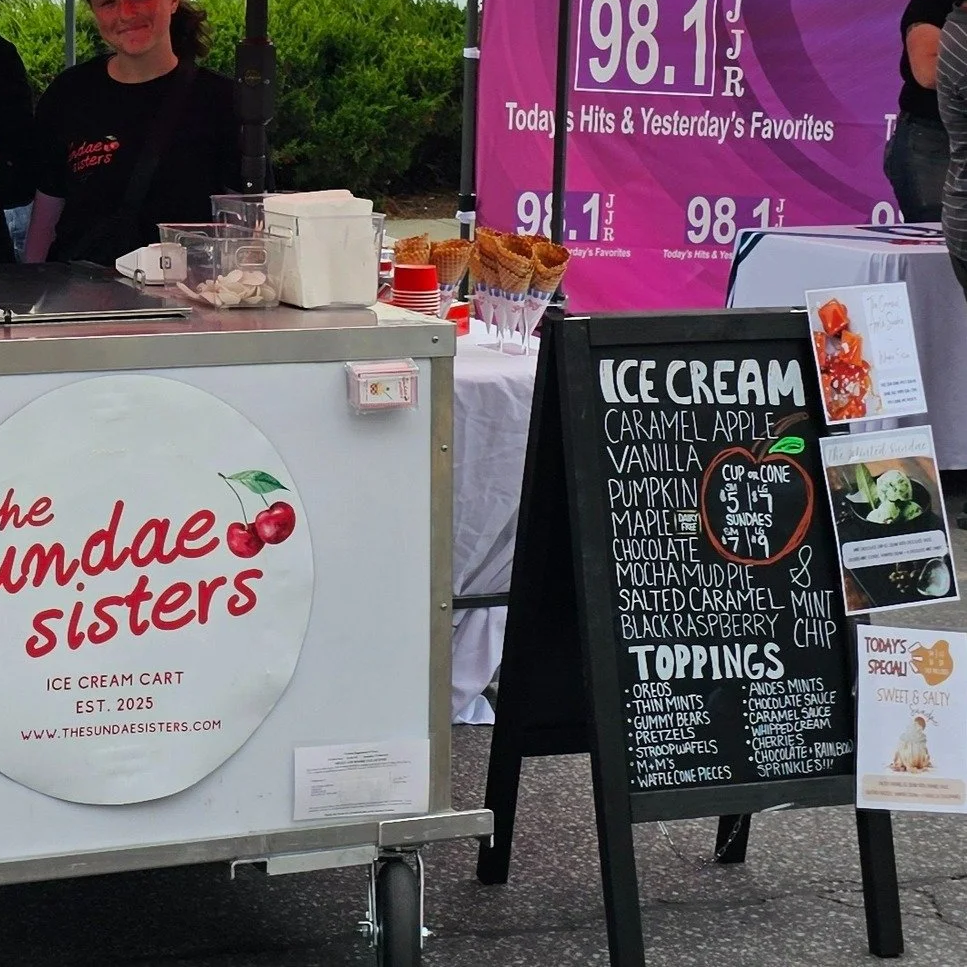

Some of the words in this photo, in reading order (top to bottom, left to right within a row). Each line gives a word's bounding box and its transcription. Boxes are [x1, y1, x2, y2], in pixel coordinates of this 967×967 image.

[505, 101, 574, 139] Todays
[580, 104, 615, 134] Hits
[621, 105, 634, 134] &
[640, 107, 744, 145] Yesterday's
[750, 111, 834, 142] Favorites
[687, 196, 770, 244] 981
[595, 247, 631, 258] Favorites
[663, 249, 693, 260] Today's
[694, 250, 710, 259] Hits
[600, 359, 659, 404] ICE
[666, 359, 806, 406] CREAM
[605, 409, 707, 443] CARAMEL
[712, 410, 779, 442] APPLE
[607, 443, 703, 473] VANILLA
[722, 464, 745, 482] CUP
[760, 464, 790, 483] CONE
[608, 477, 698, 508] PUMPKIN
[612, 509, 673, 537] MAPLE
[681, 522, 697, 532] FREE
[725, 512, 772, 527] SUNDAES
[613, 537, 701, 562] CHOCOLATE
[616, 562, 681, 587] MOCHA
[682, 563, 724, 588] MUD
[727, 563, 754, 590] PIE
[618, 588, 685, 612] SALTED
[689, 587, 785, 612] CARAMEL
[790, 590, 834, 619] MINT
[25, 568, 264, 658] sisters
[620, 613, 673, 639] BLACK
[673, 612, 779, 638] RASPBERRY
[793, 618, 837, 650] CHIP
[864, 637, 907, 654] TODAY'S
[628, 642, 785, 680] TOPPINGS
[46, 677, 72, 691] ICE
[78, 674, 133, 689] CREAM
[139, 671, 184, 686] CART
[633, 682, 672, 699] OREOS
[749, 681, 785, 696] ANDES
[787, 677, 824, 693] MINTS
[76, 699, 111, 714] EST.
[117, 697, 154, 711] 2025
[632, 697, 664, 714] THIN
[665, 694, 704, 712] MINTS
[748, 694, 802, 711] CHOCOLATE
[804, 690, 836, 706] SAUCE
[877, 688, 908, 704] SWEET
[912, 690, 920, 705] &
[922, 691, 950, 707] SALTY
[633, 713, 673, 730] GUMMY
[676, 711, 711, 727] BEARS
[749, 710, 800, 724] CARAMEL
[801, 706, 831, 719] SAUCE
[21, 719, 222, 741] WWW.THESUNDAESISTERS.COM
[635, 727, 696, 745] PRETZELS
[751, 722, 793, 737] WHIPPED
[794, 718, 831, 732] CREAM
[635, 739, 718, 758] STROOPWAFELS
[752, 734, 804, 751] CHERRIES
[754, 746, 807, 764] CHOCOLATE
[637, 771, 673, 788] WAFFLE
[673, 769, 696, 784] CONE
[697, 765, 732, 781] PIECES
[757, 759, 834, 778] SPRINKLES!!!
